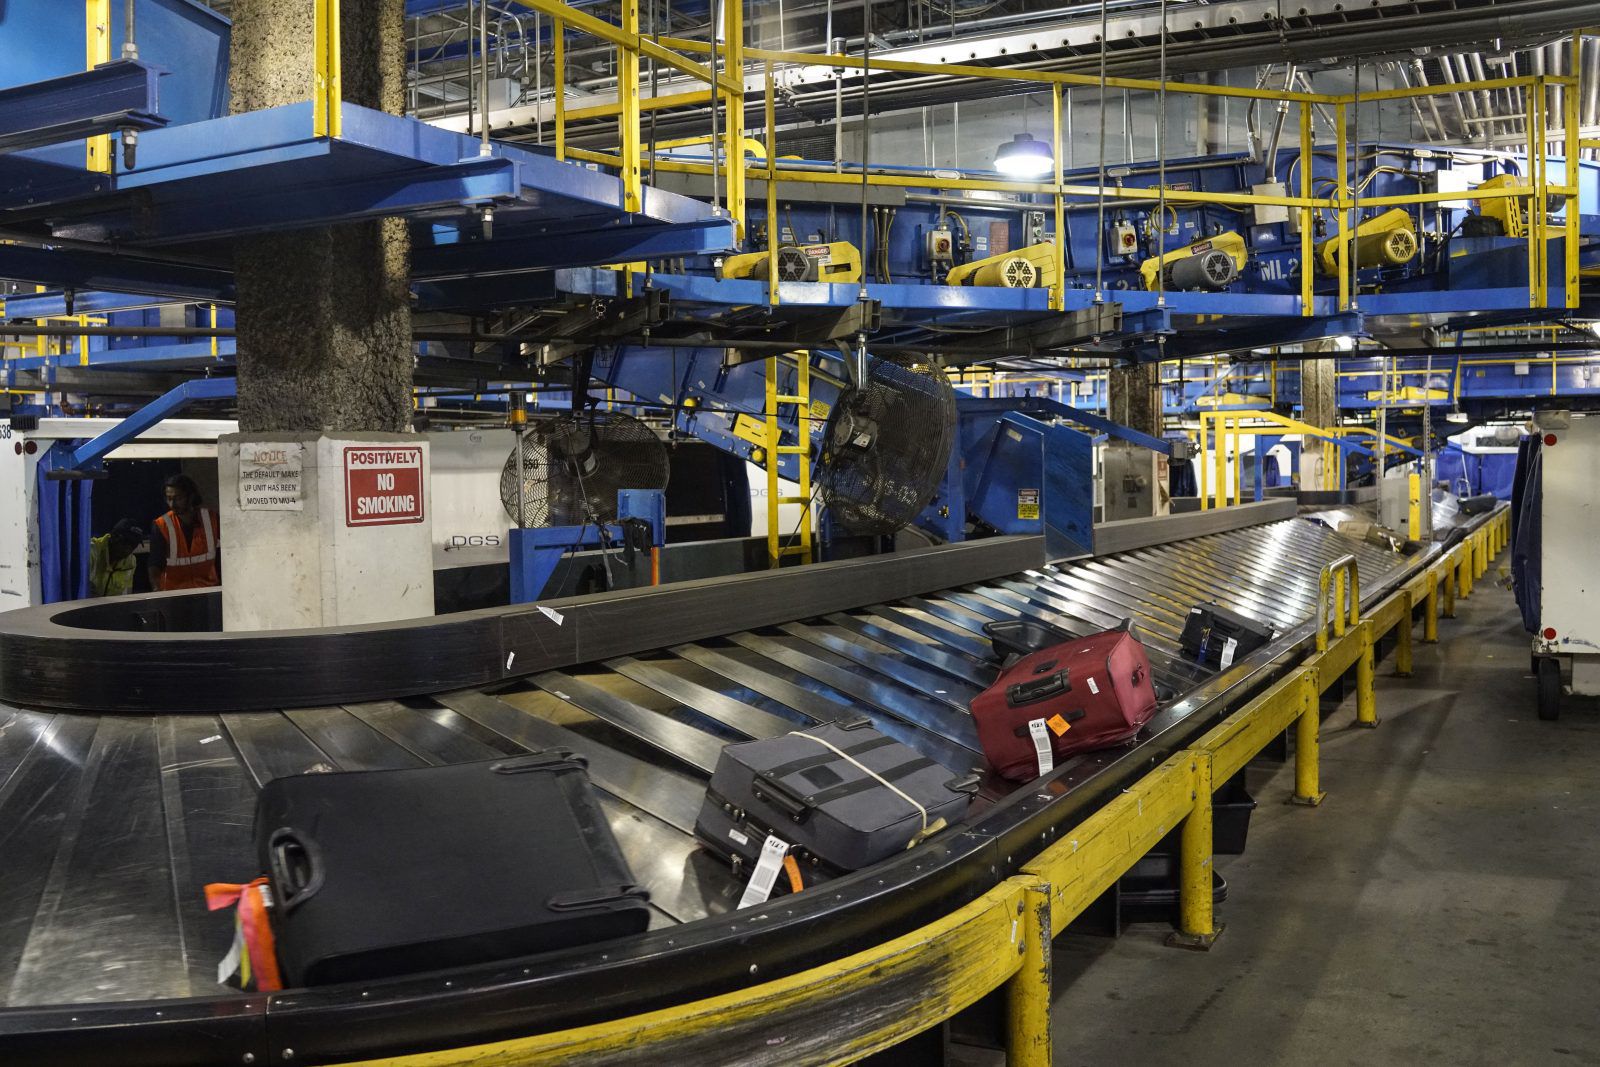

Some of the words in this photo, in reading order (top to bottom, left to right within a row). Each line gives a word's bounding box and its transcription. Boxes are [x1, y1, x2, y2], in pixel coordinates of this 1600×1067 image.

[0, 424, 11, 439] 38
[351, 452, 416, 464] POSITIVELY
[243, 471, 253, 479] THE
[255, 470, 280, 479] DEFAULT
[281, 470, 299, 478] MAKE
[377, 472, 395, 491] NO
[247, 497, 269, 505] MOVED
[269, 497, 278, 505] TO
[357, 494, 415, 515] SMOKING
[452, 535, 500, 547] DGS
